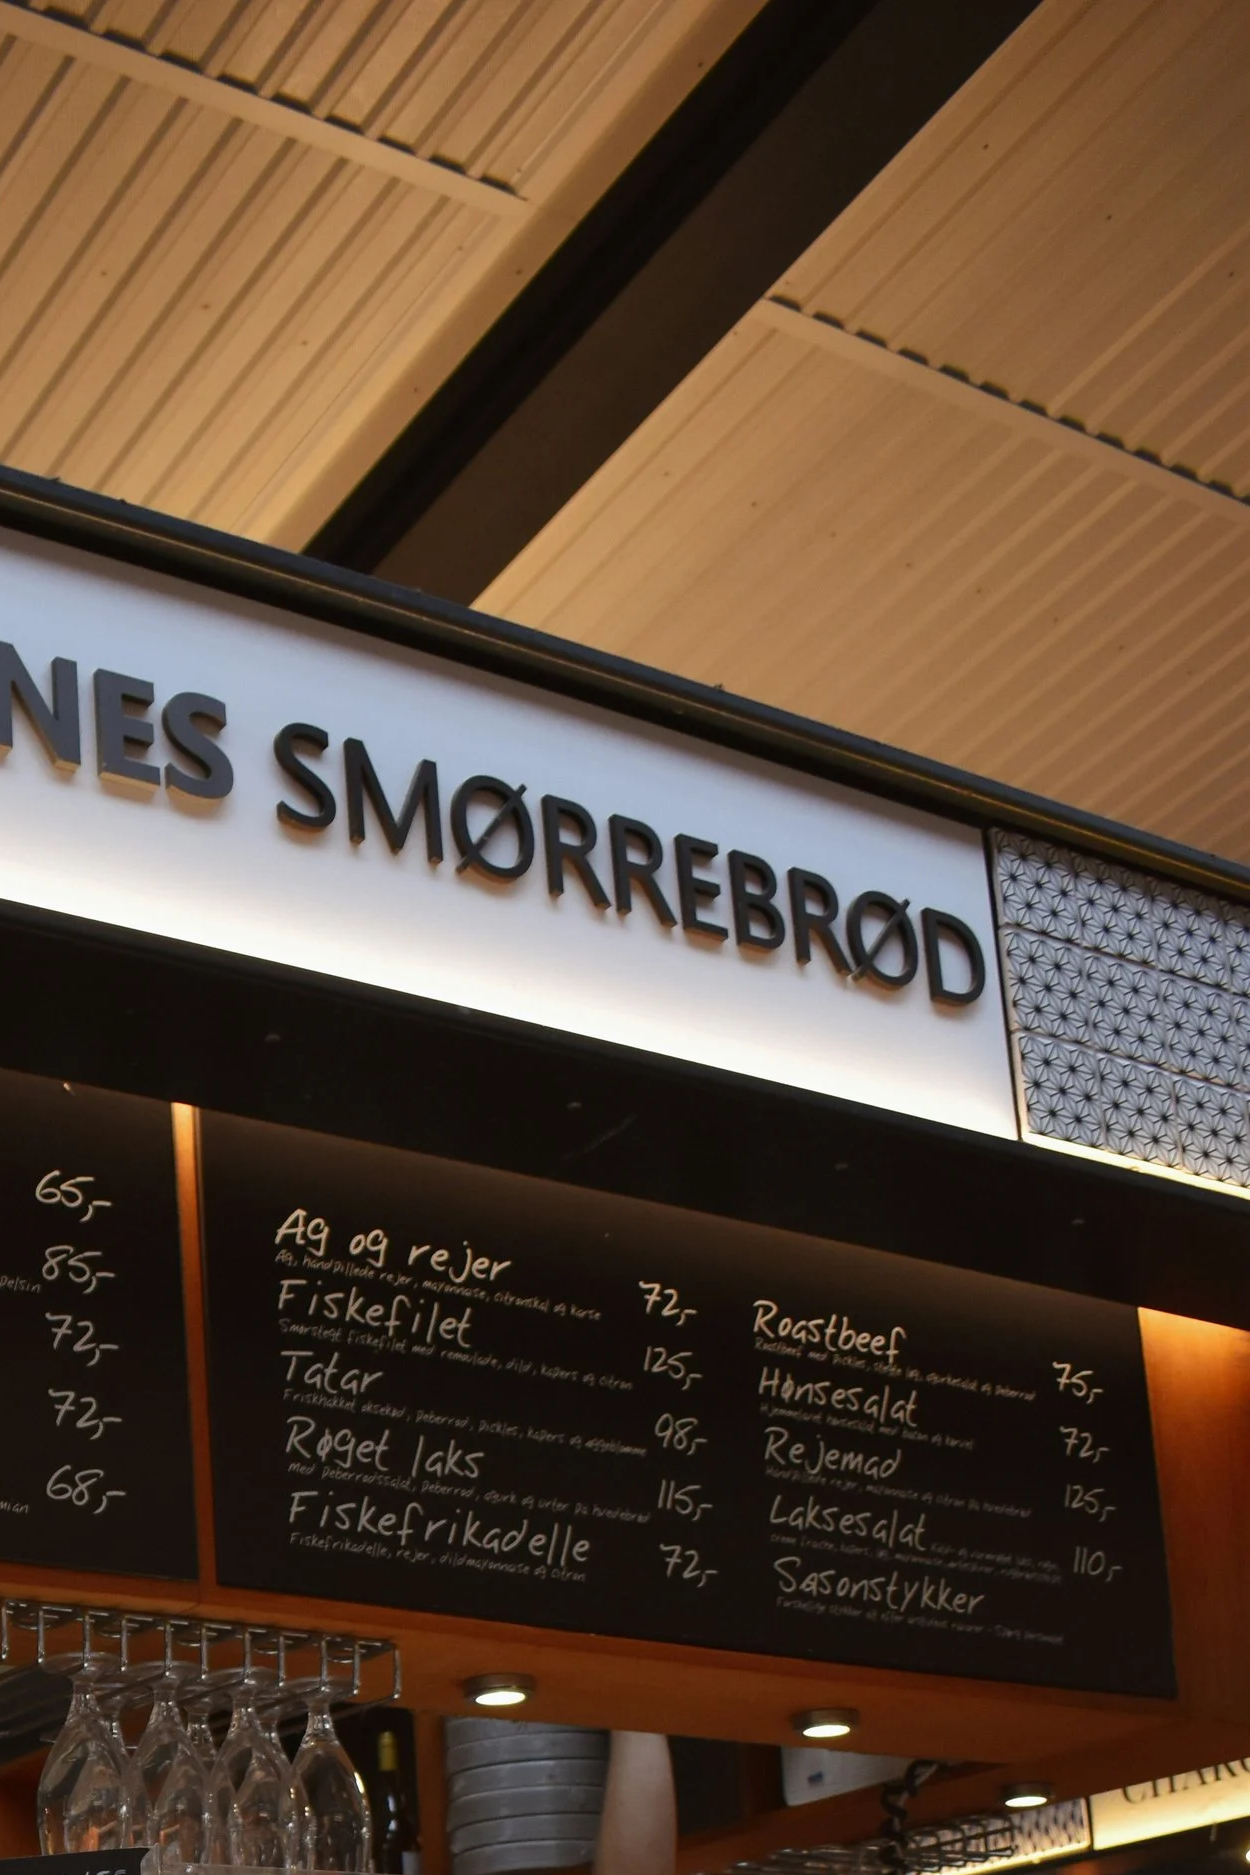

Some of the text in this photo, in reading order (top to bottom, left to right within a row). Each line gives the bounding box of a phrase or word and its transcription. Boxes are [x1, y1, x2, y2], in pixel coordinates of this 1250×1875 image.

[273, 722, 987, 1008] SMØRREBRØD
[349, 1228, 389, 1268] og
[407, 1240, 512, 1284] rejer
[277, 1278, 475, 1350] Fiskefilet
[752, 1299, 909, 1365] Roastbeef
[279, 1350, 385, 1396] Tatar
[758, 1366, 919, 1428] Hønsesalat
[285, 1415, 390, 1472] Røget
[411, 1434, 485, 1479] laks
[763, 1425, 903, 1480] Rejemad
[288, 1489, 591, 1568] Fiskefrikadelle
[769, 1494, 926, 1551] Laksesalat
